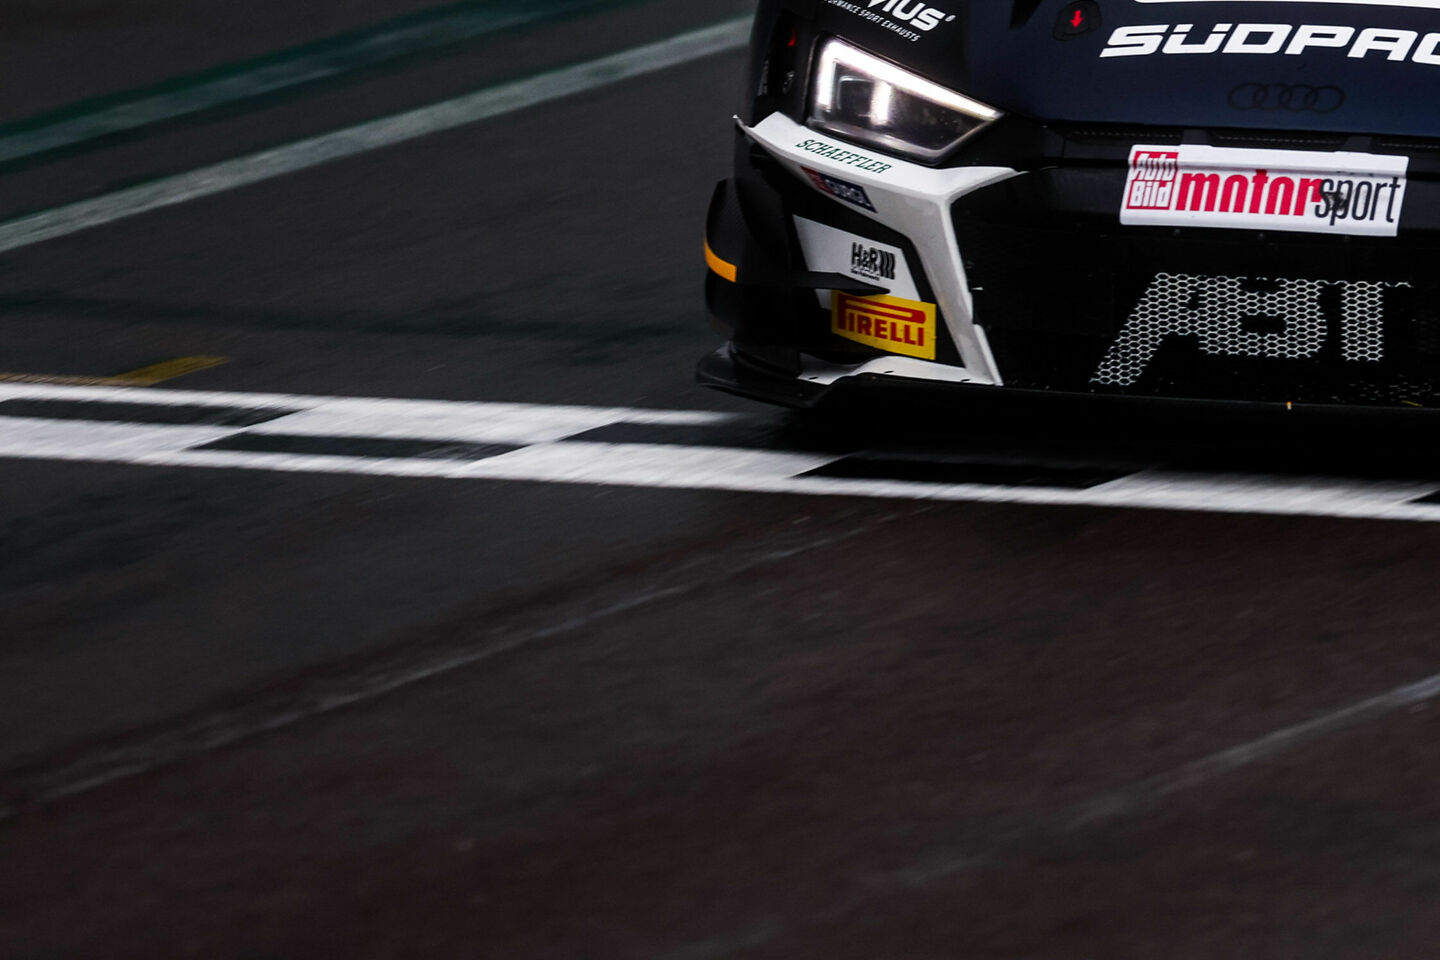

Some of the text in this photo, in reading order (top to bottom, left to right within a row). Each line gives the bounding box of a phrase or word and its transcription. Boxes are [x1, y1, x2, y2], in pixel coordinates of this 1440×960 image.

[859, 7, 885, 24] SPORT
[880, 18, 921, 42] EXHAUSTS
[795, 139, 892, 174] SCHAEFFLER
[1128, 180, 1175, 207] Bild
[852, 242, 880, 272] H&R
[837, 291, 926, 347] PIRELLI
[1090, 272, 1413, 386] ABT
